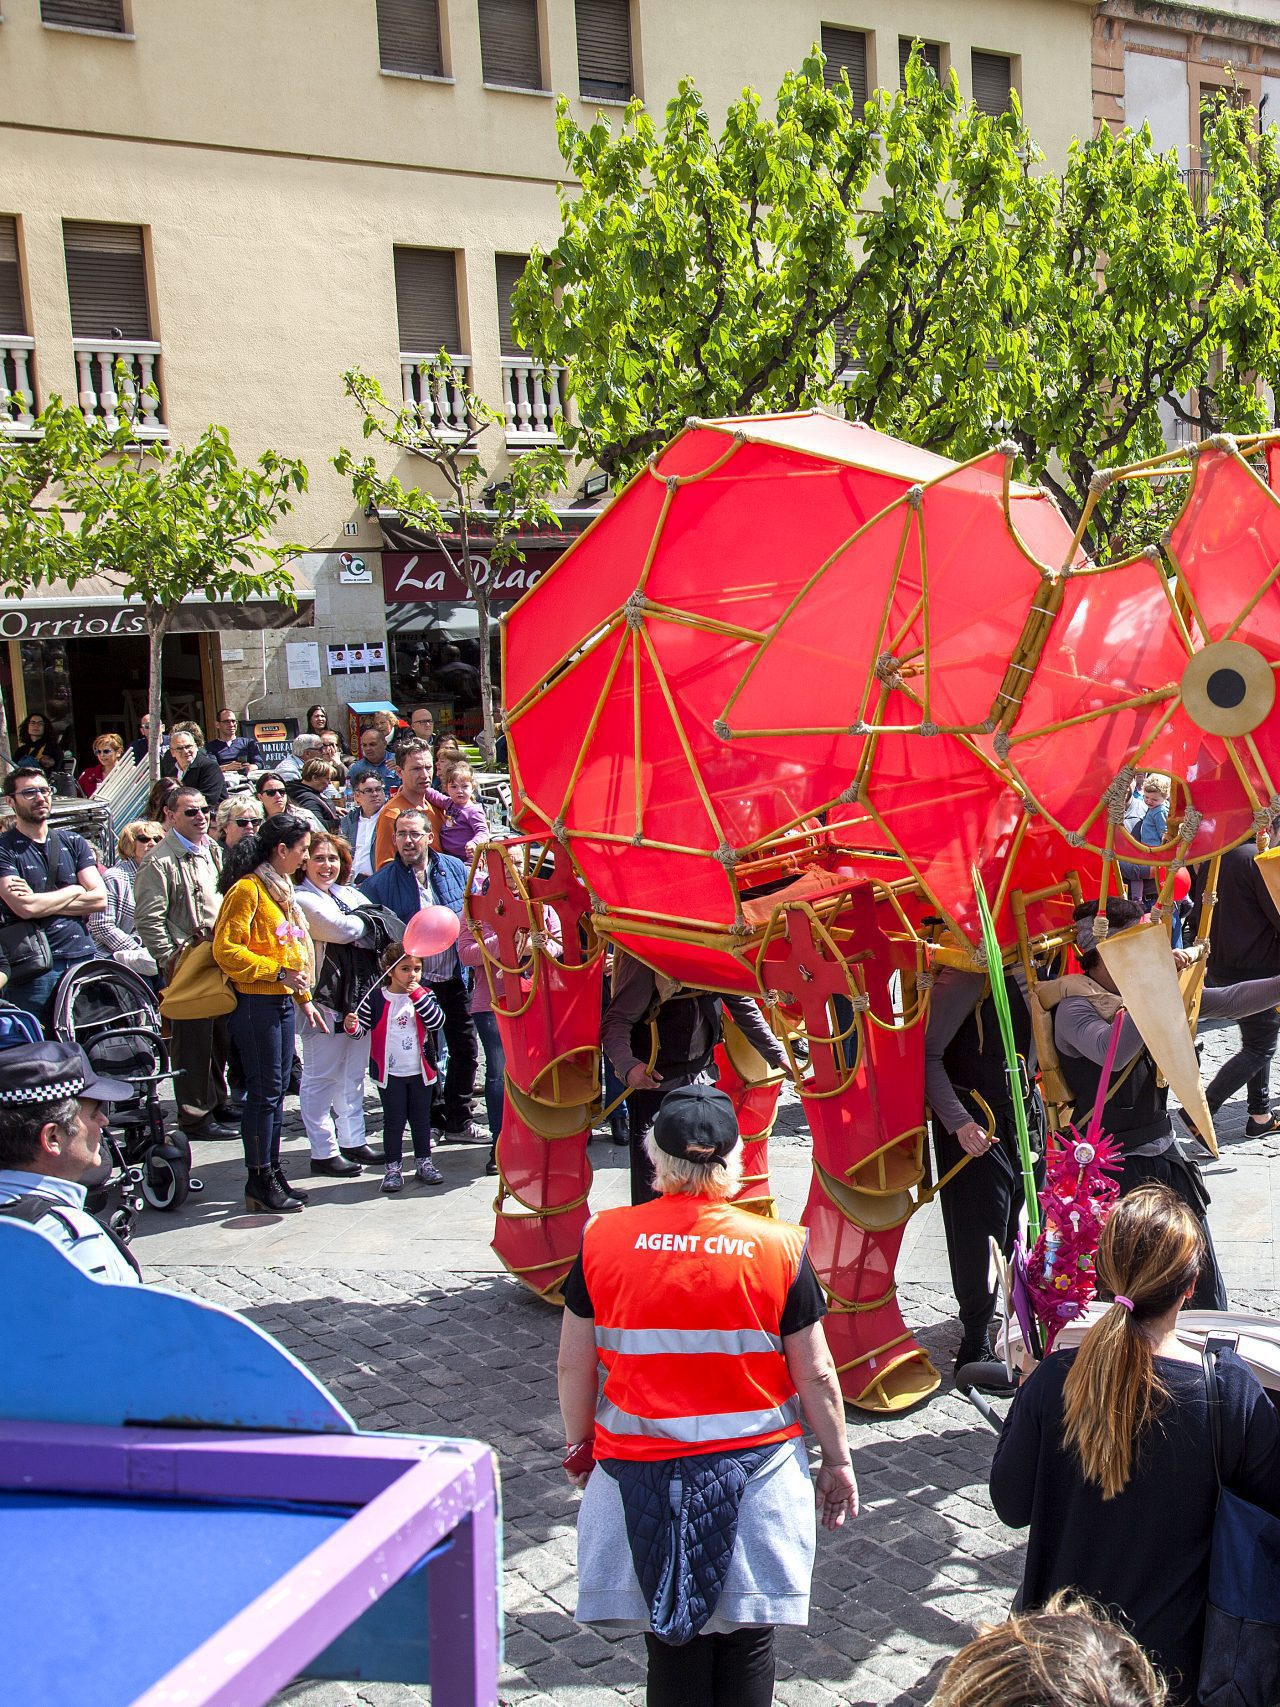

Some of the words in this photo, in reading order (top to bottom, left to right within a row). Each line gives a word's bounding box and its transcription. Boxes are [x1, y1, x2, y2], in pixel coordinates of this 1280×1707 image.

[345, 523, 356, 535] 11
[395, 555, 445, 592] La
[0, 608, 146, 637] Orriols
[634, 1233, 700, 1252] AGENT
[704, 1234, 755, 1258] CÍVIC
